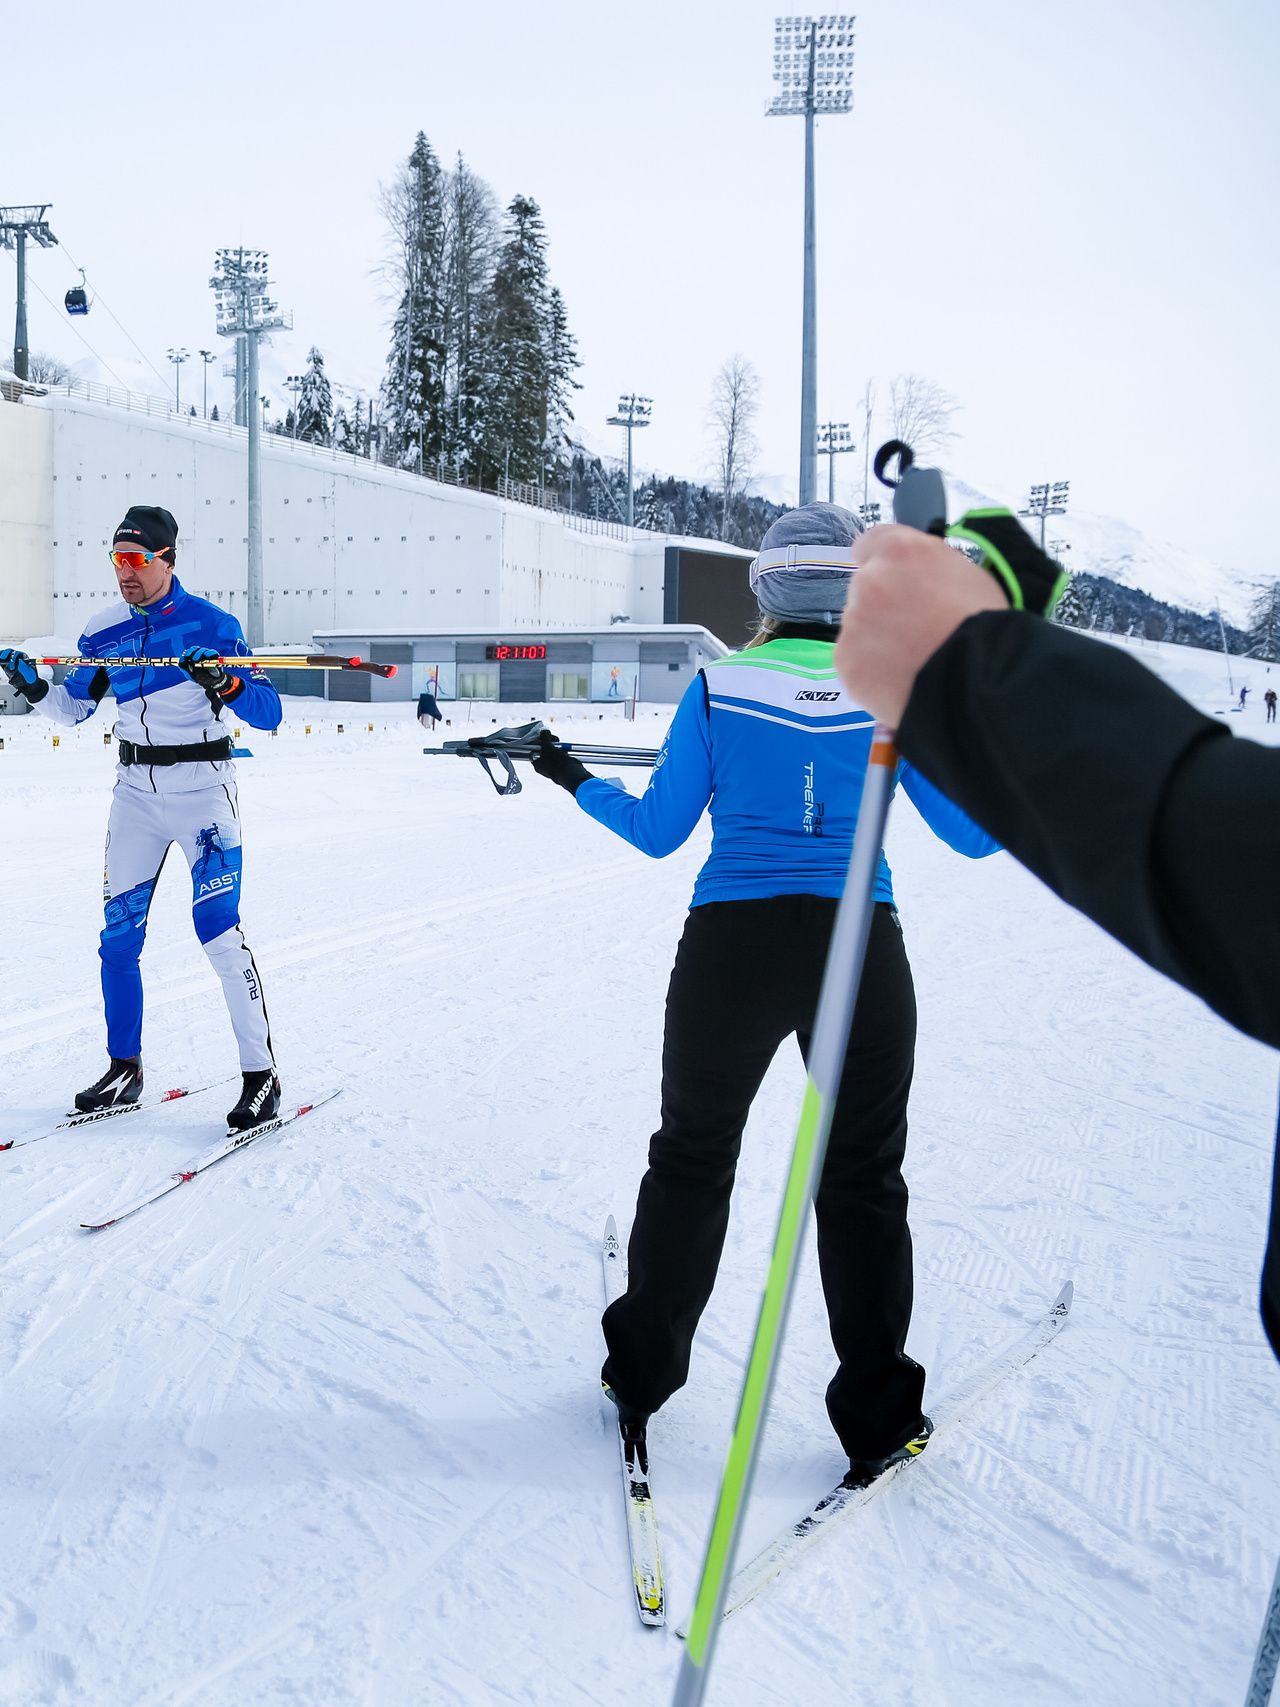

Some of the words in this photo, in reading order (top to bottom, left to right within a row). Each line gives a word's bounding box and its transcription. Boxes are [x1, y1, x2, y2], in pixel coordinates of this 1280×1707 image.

[496, 645, 546, 660] 12:11:07
[814, 802, 825, 838] PRO
[199, 870, 239, 895] ABST
[243, 968, 259, 1000] RUS
[249, 1068, 278, 1117] MADSHU
[68, 1103, 143, 1128] MADSHUS
[233, 1119, 283, 1147] MADSHUS
[604, 1241, 619, 1250] 200
